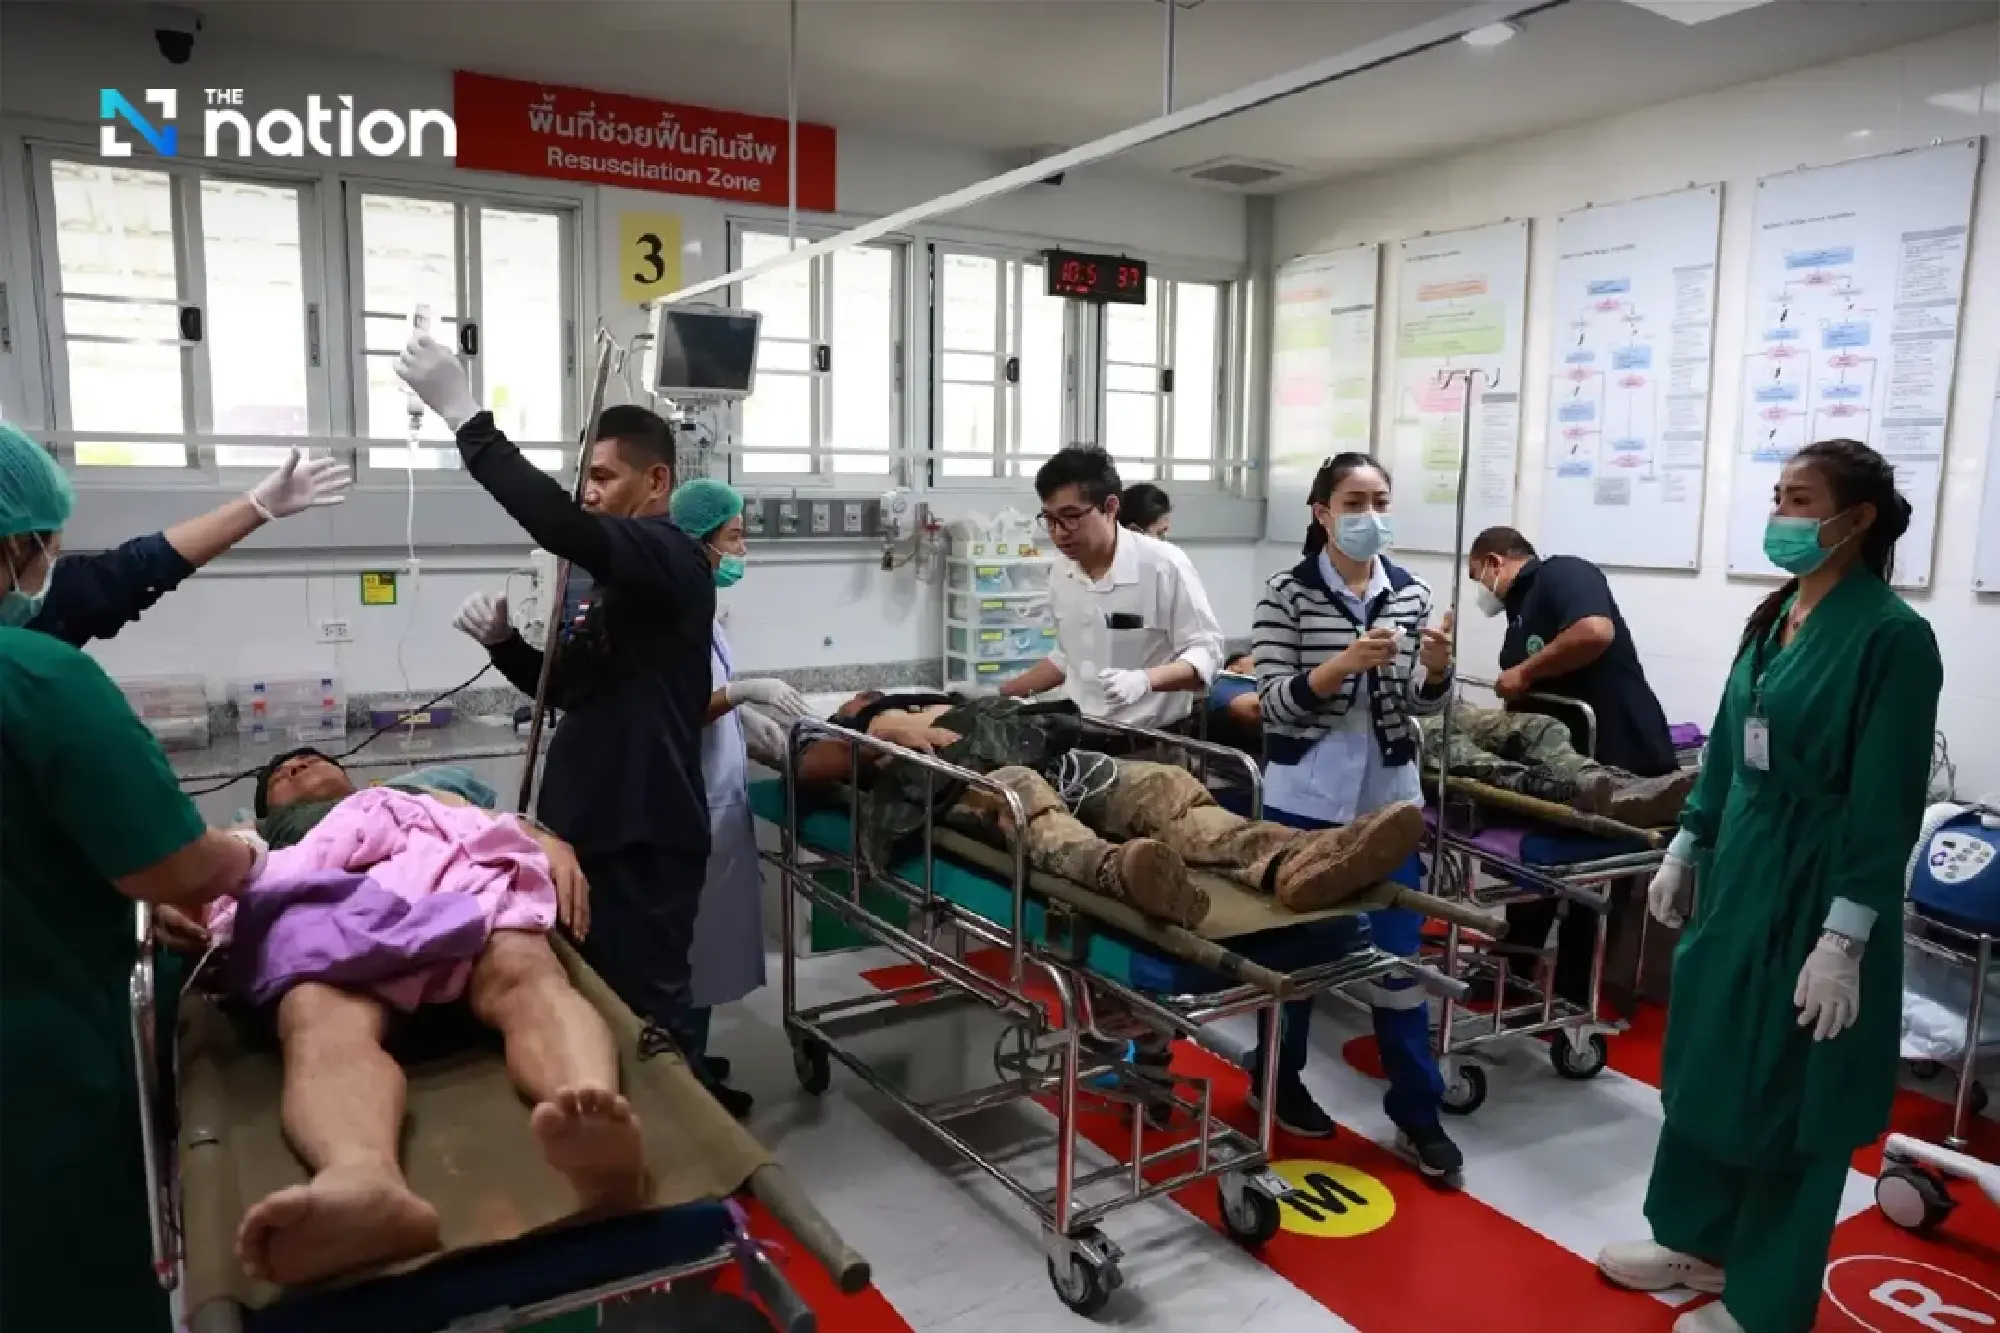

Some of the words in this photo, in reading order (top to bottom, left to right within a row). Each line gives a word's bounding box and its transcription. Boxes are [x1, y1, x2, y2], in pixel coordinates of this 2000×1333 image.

[528, 93, 778, 166] พื้นที่ช่วยฟื้นคืนชีพ
[547, 145, 701, 184] Resuscitation
[706, 166, 761, 193] Zone
[633, 232, 666, 284] 3
[1281, 1172, 1370, 1223] M
[1869, 1278, 1997, 1333] R
